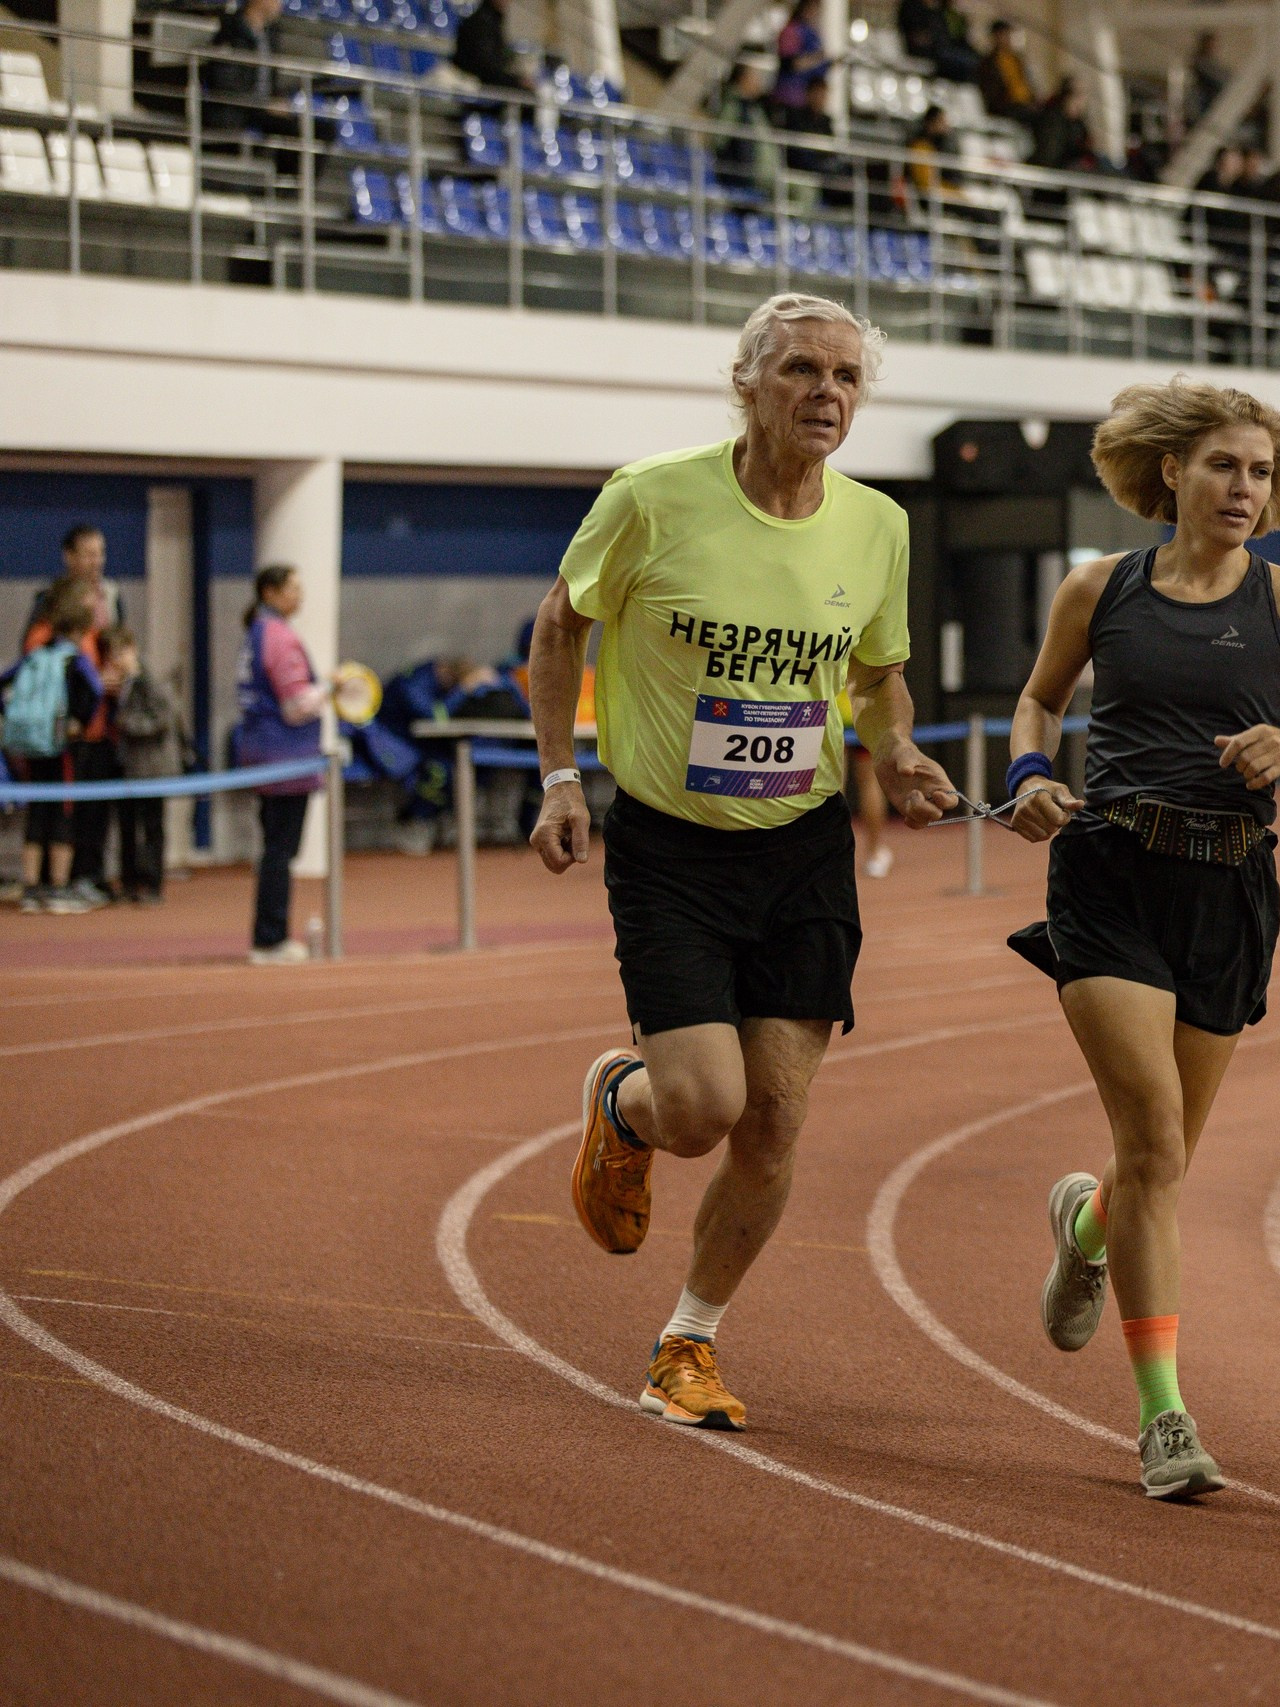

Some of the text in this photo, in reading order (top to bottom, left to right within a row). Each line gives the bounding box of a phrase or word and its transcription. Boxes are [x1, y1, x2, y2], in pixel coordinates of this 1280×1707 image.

[824, 600, 851, 608] DEMIX
[669, 611, 852, 662] НЕЗРЯЧИЙ
[1211, 639, 1247, 649] DEMIX
[706, 650, 817, 685] БЕГУН
[723, 734, 795, 764] 208
